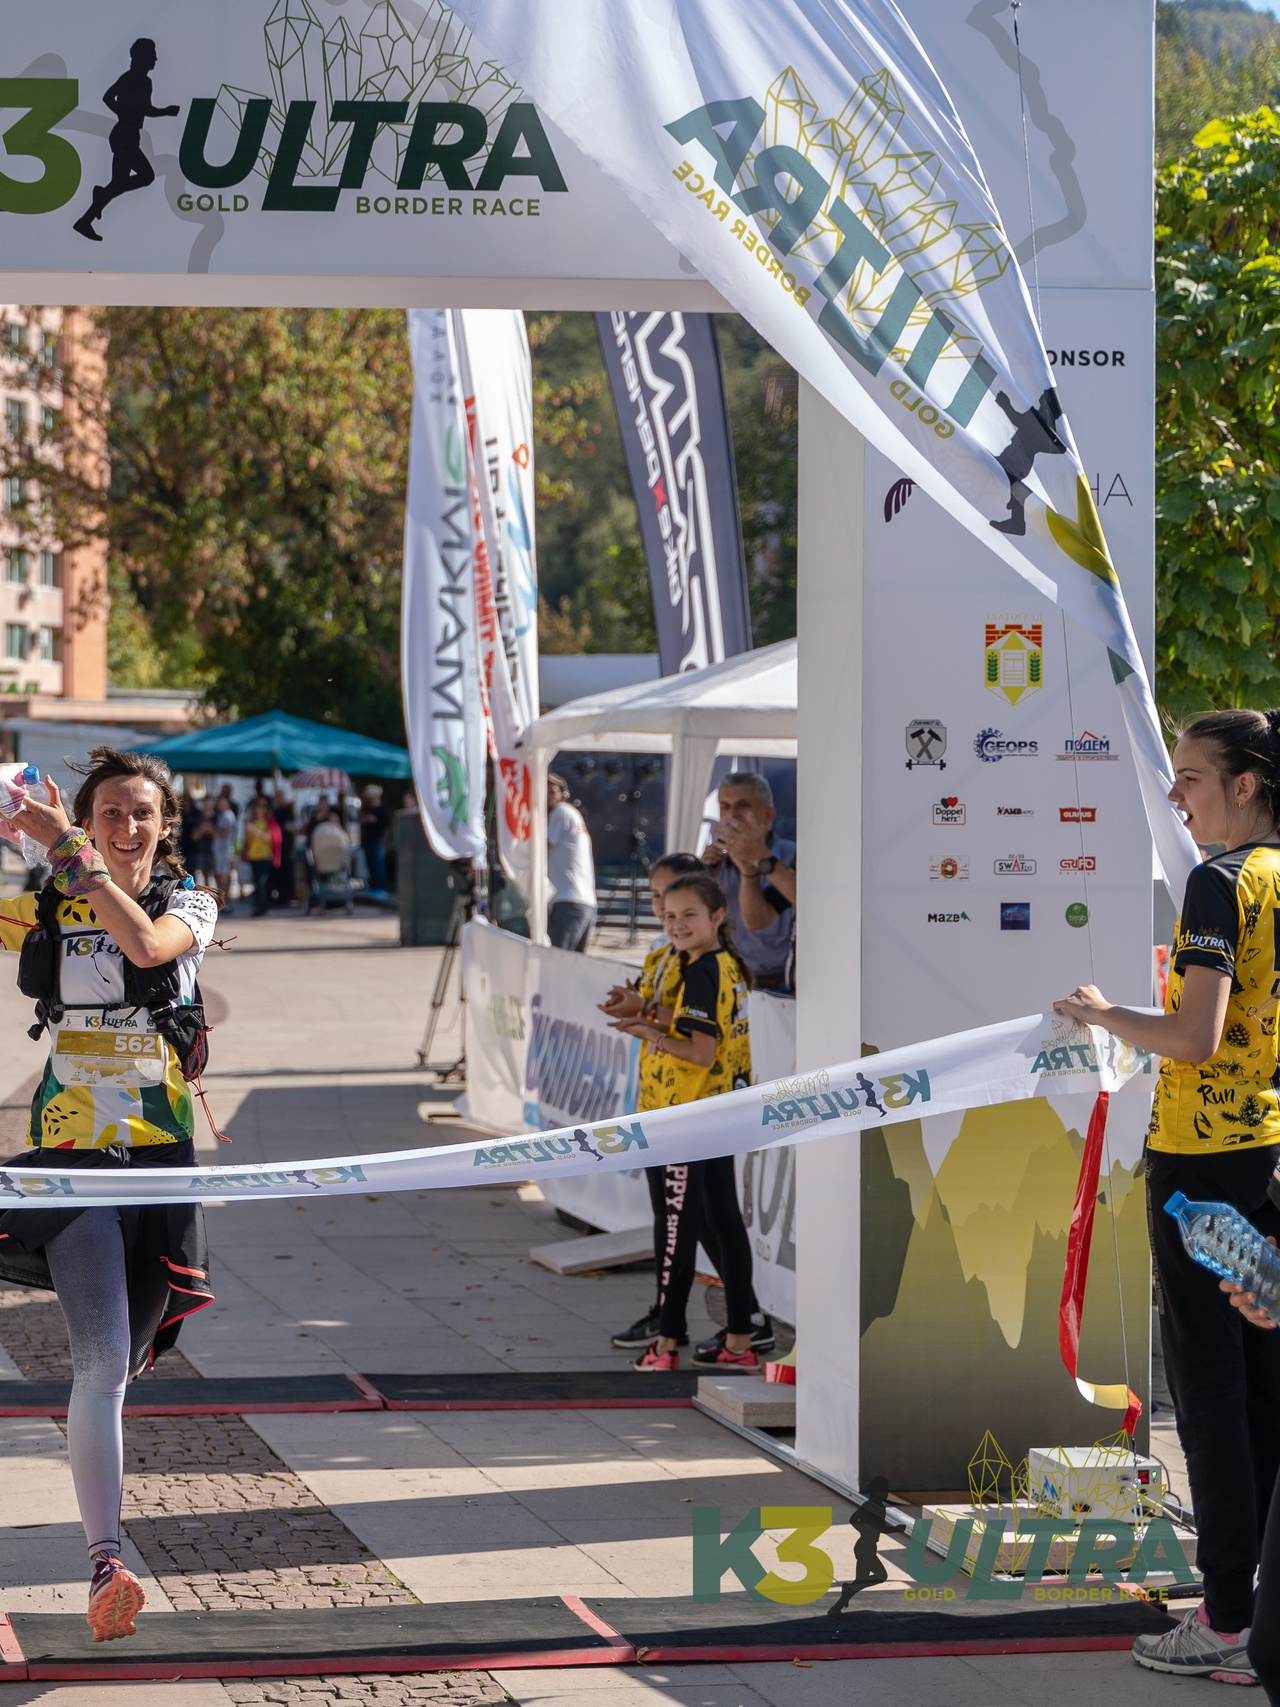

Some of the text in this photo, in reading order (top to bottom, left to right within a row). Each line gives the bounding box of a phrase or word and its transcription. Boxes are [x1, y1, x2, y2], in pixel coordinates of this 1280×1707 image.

[178, 98, 569, 212] ULTRA
[177, 195, 541, 217] GOLD BORDER RACE
[1046, 349, 1126, 367] ONSOR
[985, 613, 1044, 621] ЗЛАТОГРАД
[984, 741, 1039, 754] GEOPS
[1065, 740, 1110, 752] ПОДЕМ
[936, 807, 963, 817] Doppel
[941, 815, 958, 823] herz
[927, 913, 960, 923] Maze
[66, 937, 94, 957] K3
[1190, 933, 1226, 950] ULTRA
[85, 1015, 100, 1028] K3
[114, 1035, 156, 1053] 562
[1196, 1083, 1236, 1107] Run
[665, 1165, 689, 1211] PPY
